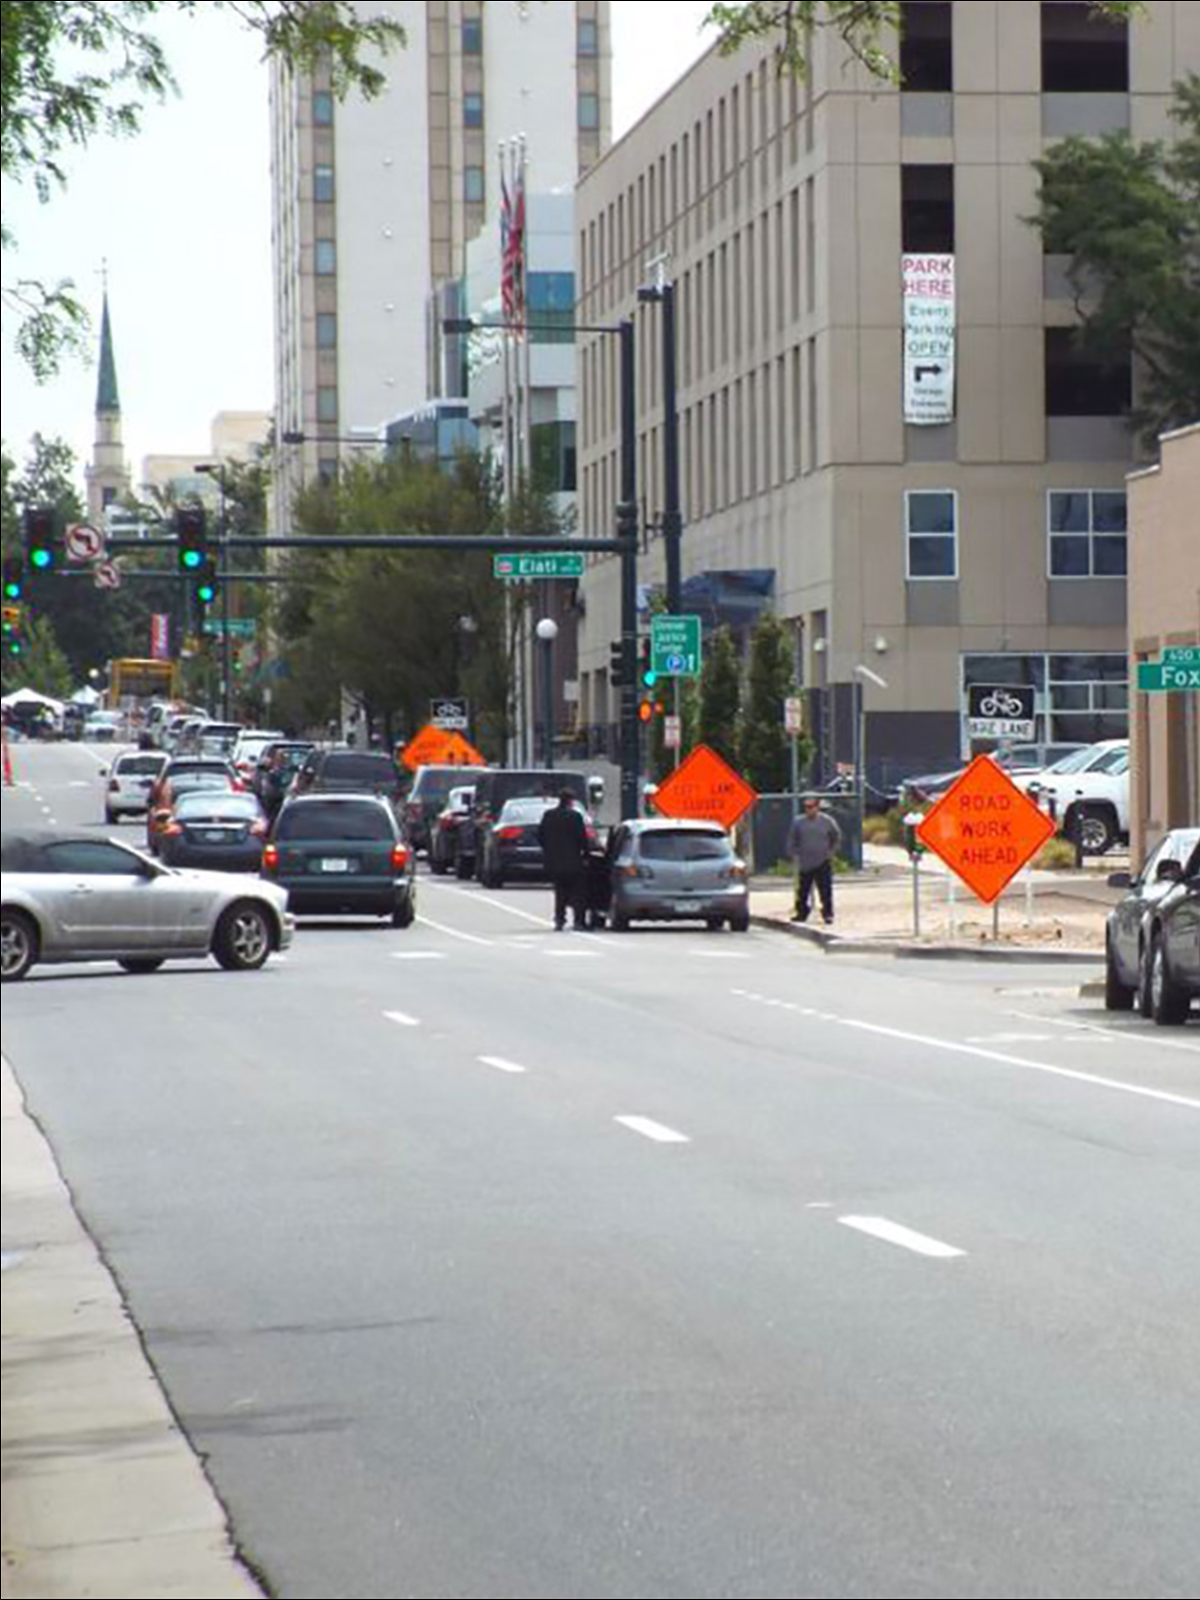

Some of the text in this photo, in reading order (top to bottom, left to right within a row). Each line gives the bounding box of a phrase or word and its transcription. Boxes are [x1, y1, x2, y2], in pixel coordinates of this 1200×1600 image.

[902, 258, 952, 273] PARK
[902, 279, 952, 295] HERE
[907, 340, 951, 354] OPEN
[519, 558, 557, 574] Elati
[1161, 666, 1200, 687] Fox
[1000, 722, 1031, 737] LANE
[959, 794, 1011, 812] ROAD
[959, 820, 1012, 838] WORK
[960, 846, 1018, 866] AHEAD
